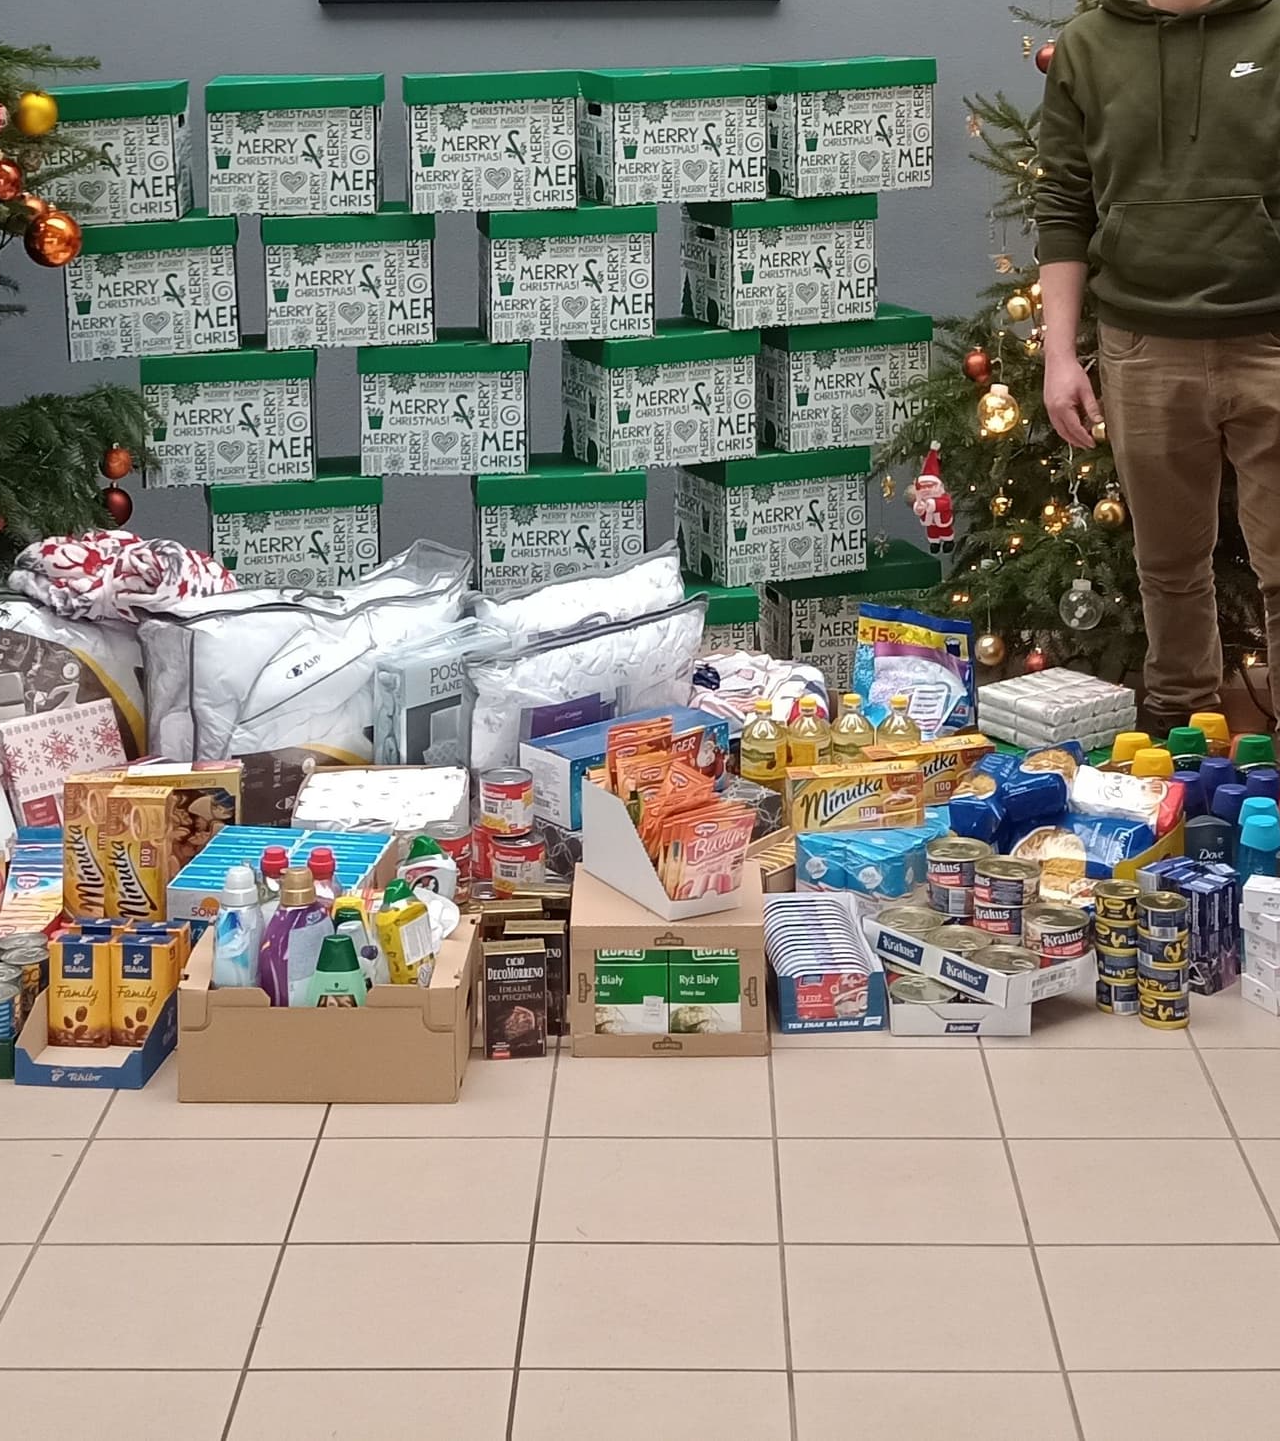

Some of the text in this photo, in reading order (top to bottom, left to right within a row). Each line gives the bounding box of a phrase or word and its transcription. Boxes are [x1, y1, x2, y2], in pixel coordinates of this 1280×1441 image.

[643, 127, 699, 144] MERRY
[823, 119, 872, 136] MERRY
[123, 127, 138, 176] MERRY
[237, 137, 298, 155] MERRY
[441, 134, 501, 152] MERRY
[618, 162, 660, 174] MERRY
[801, 153, 838, 166] MERRY
[209, 172, 255, 185] MERRY
[415, 169, 460, 182] MERRY
[759, 250, 810, 268] MERRY
[294, 269, 356, 287] MERRY
[520, 263, 579, 280] MERRY
[96, 278, 160, 298] MERRY
[736, 285, 774, 299] MERRY
[268, 304, 313, 318] MERRY
[493, 298, 537, 311] MERRY
[70, 316, 117, 331] MERRY
[814, 372, 865, 391] MERRY
[389, 397, 449, 416] MERRY
[636, 387, 689, 408] MERRY
[173, 407, 235, 426] MERRY
[791, 407, 830, 421] MERRY
[362, 432, 407, 446] MERRY
[612, 424, 652, 440] MERRY
[752, 504, 803, 525] MERRY
[244, 535, 305, 554] MERRY
[511, 529, 571, 547] MERRY
[729, 541, 767, 557] MERRY
[860, 625, 902, 645] +15%
[935, 781, 951, 792] 100
[800, 776, 884, 828] Minutka
[140, 848, 151, 867] 100
[1199, 847, 1225, 859] Dove
[66, 824, 105, 912] Minutka
[108, 840, 151, 918] Minutka
[1041, 929, 1084, 947] Krakus
[601, 974, 624, 987] Biały
[679, 974, 719, 987] Ryż Biały
[56, 985, 99, 1006] Family
[116, 985, 158, 1007] Family
[67, 1071, 103, 1082] Tchibo
